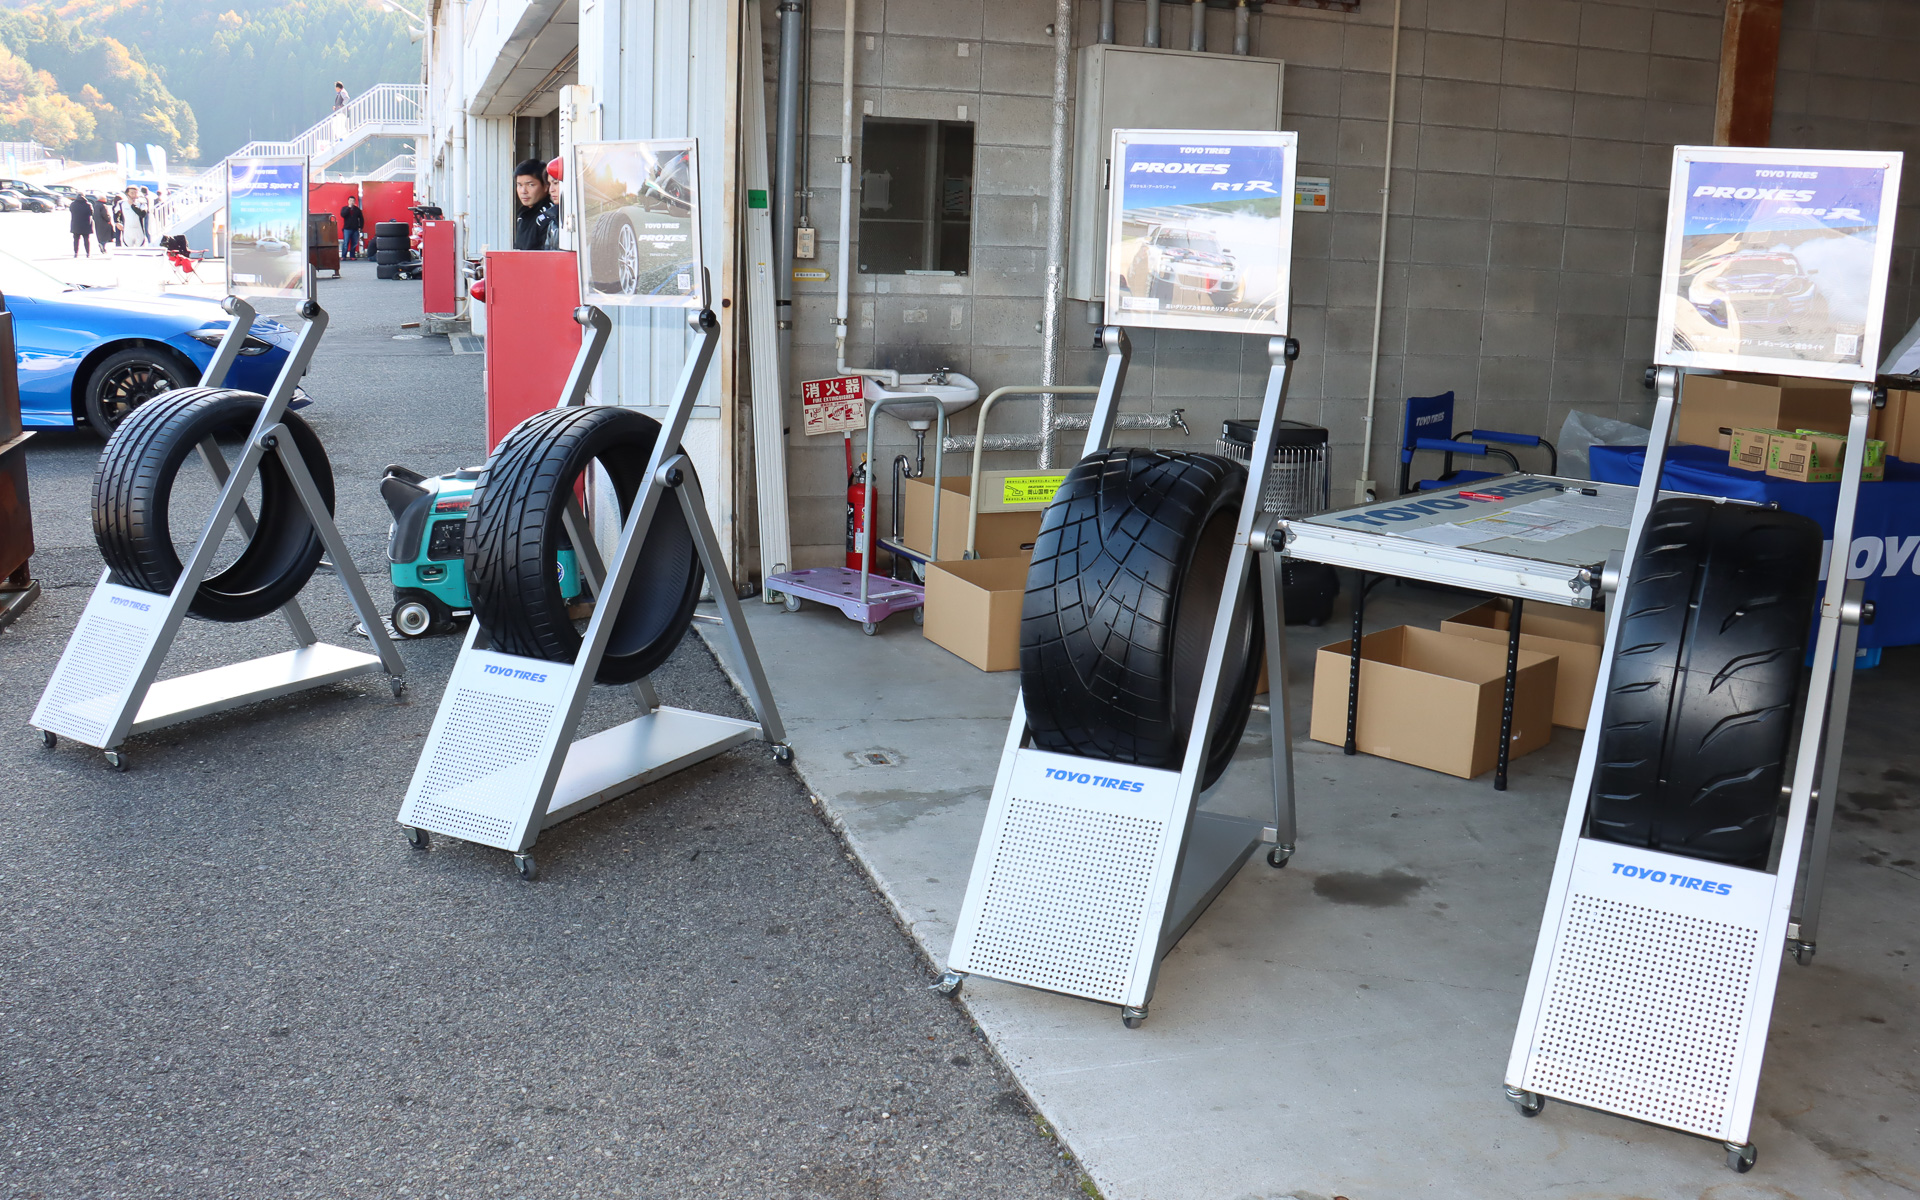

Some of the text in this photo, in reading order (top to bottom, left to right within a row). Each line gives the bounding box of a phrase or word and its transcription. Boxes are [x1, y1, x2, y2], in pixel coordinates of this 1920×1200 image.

[1130, 162, 1231, 174] PROXES
[1755, 170, 1818, 179] TOYO TIRES
[1692, 186, 1816, 202] PROXES
[806, 378, 860, 398] 消火器
[1336, 498, 1470, 526] TOYO
[110, 596, 151, 611] TOYO TIRES
[484, 664, 547, 683] TOYO TIRES
[1045, 768, 1144, 792] TOYO TIRES
[1612, 862, 1732, 896] TOYO TIRES
